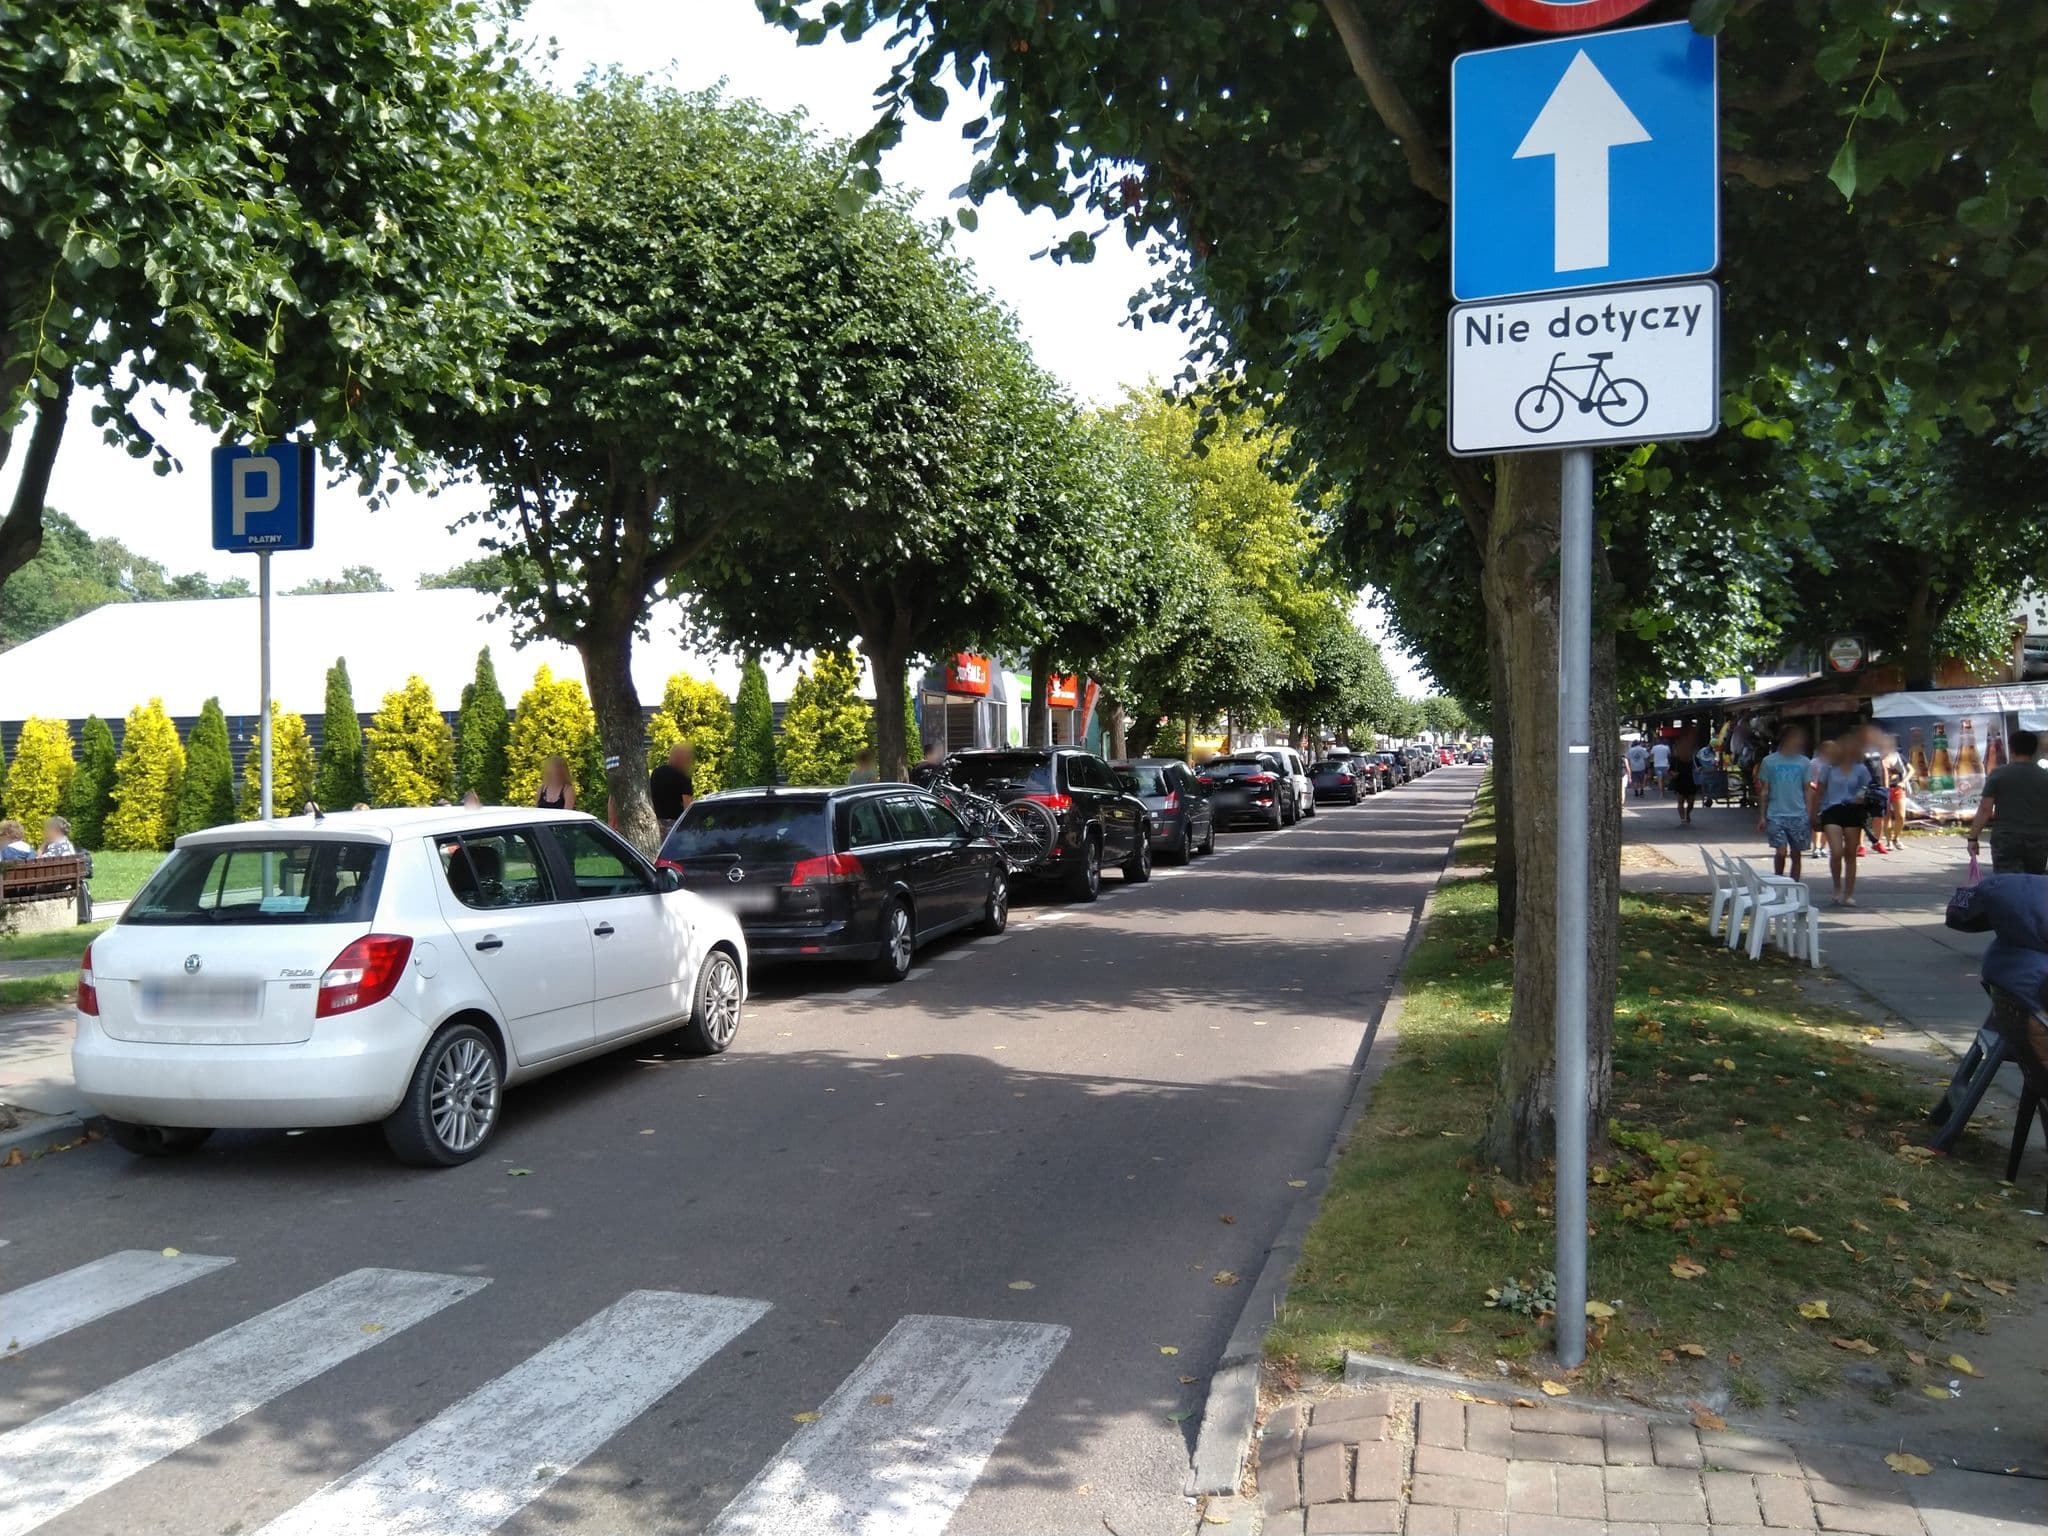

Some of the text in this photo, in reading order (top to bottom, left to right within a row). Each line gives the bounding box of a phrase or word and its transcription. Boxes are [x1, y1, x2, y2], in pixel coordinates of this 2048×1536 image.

[1465, 302, 1702, 347] Nie dotyczy
[232, 456, 281, 536] P
[248, 534, 282, 544] PŁATNY
